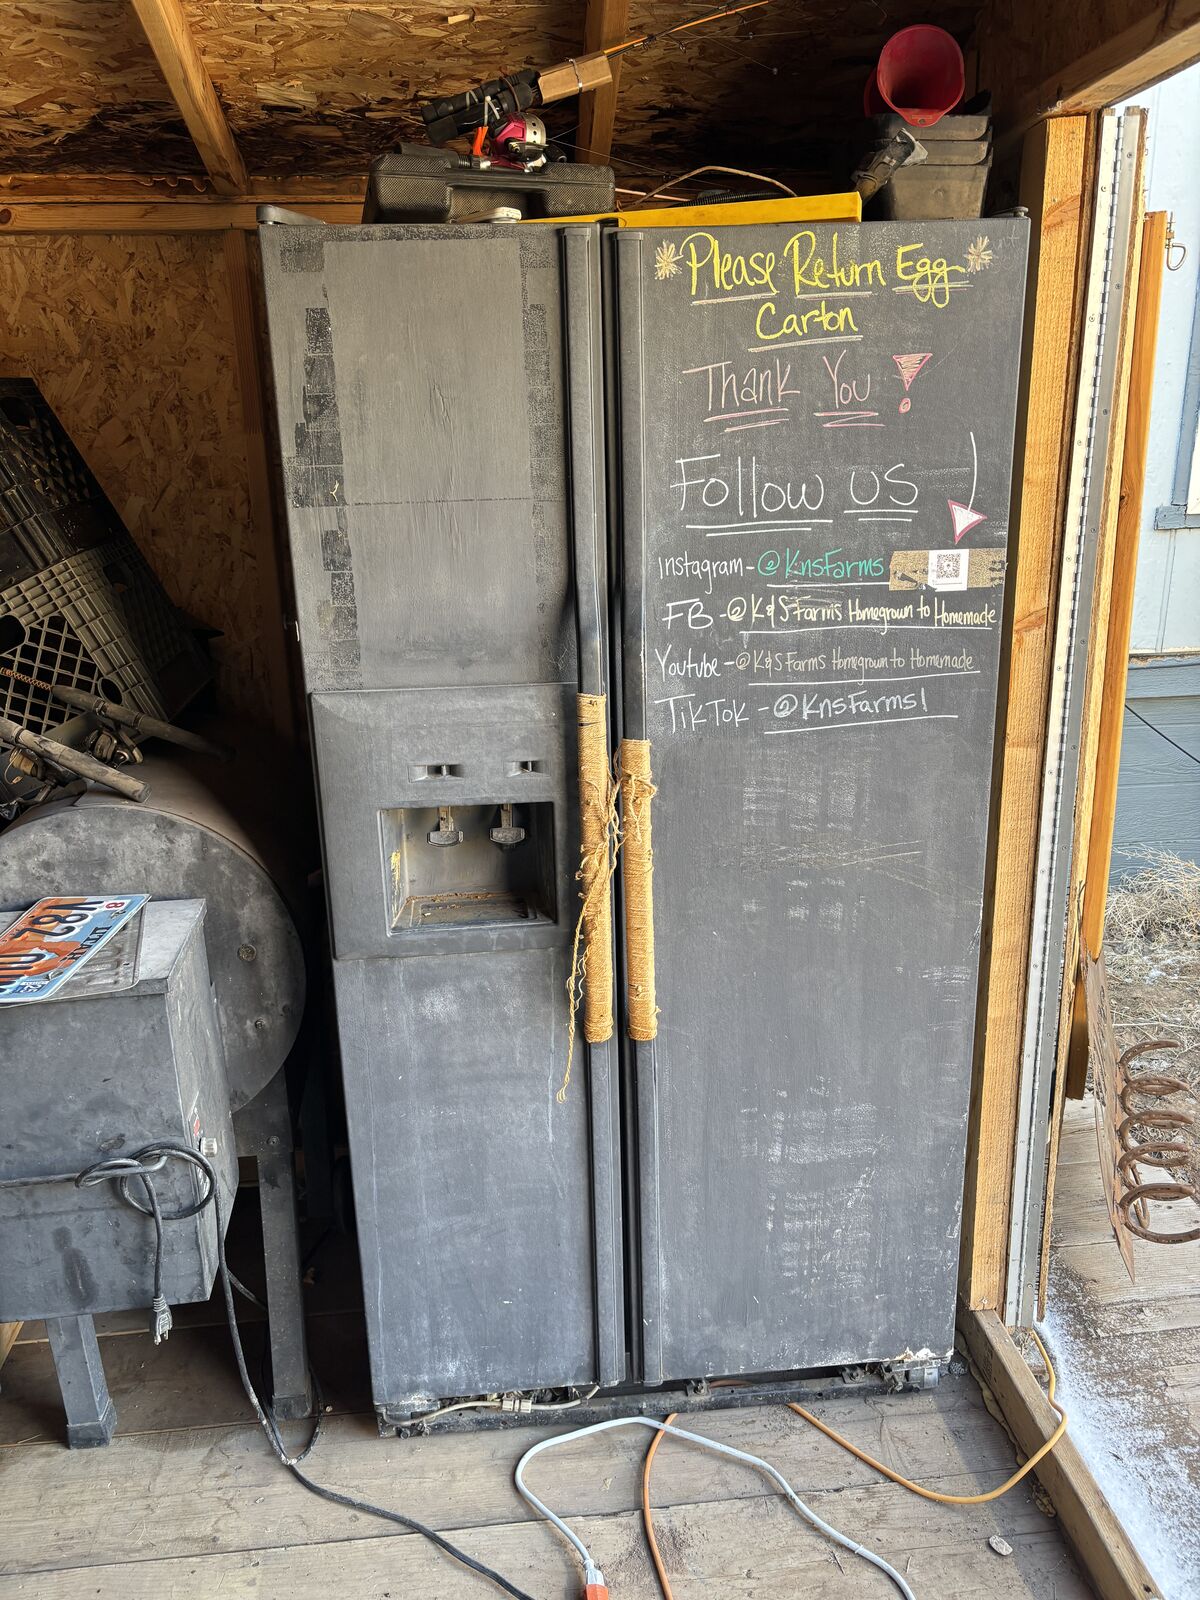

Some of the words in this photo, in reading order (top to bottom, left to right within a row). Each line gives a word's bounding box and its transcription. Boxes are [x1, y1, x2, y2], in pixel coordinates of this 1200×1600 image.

[680, 232, 778, 295] Please
[784, 230, 886, 296] Return
[896, 243, 965, 308] Egg
[755, 302, 858, 340] Carton
[683, 359, 801, 411] Thank
[823, 350, 870, 408] You
[670, 454, 824, 518] Follow
[662, 598, 713, 630] FB
[849, 598, 913, 635] Homegrown
[916, 595, 930, 619] to
[934, 597, 997, 627] Homemade
[832, 646, 889, 685] Homegrown
[889, 648, 905, 668] to
[910, 647, 974, 671] Homemade
[61, 925, 112, 962] UTAH
